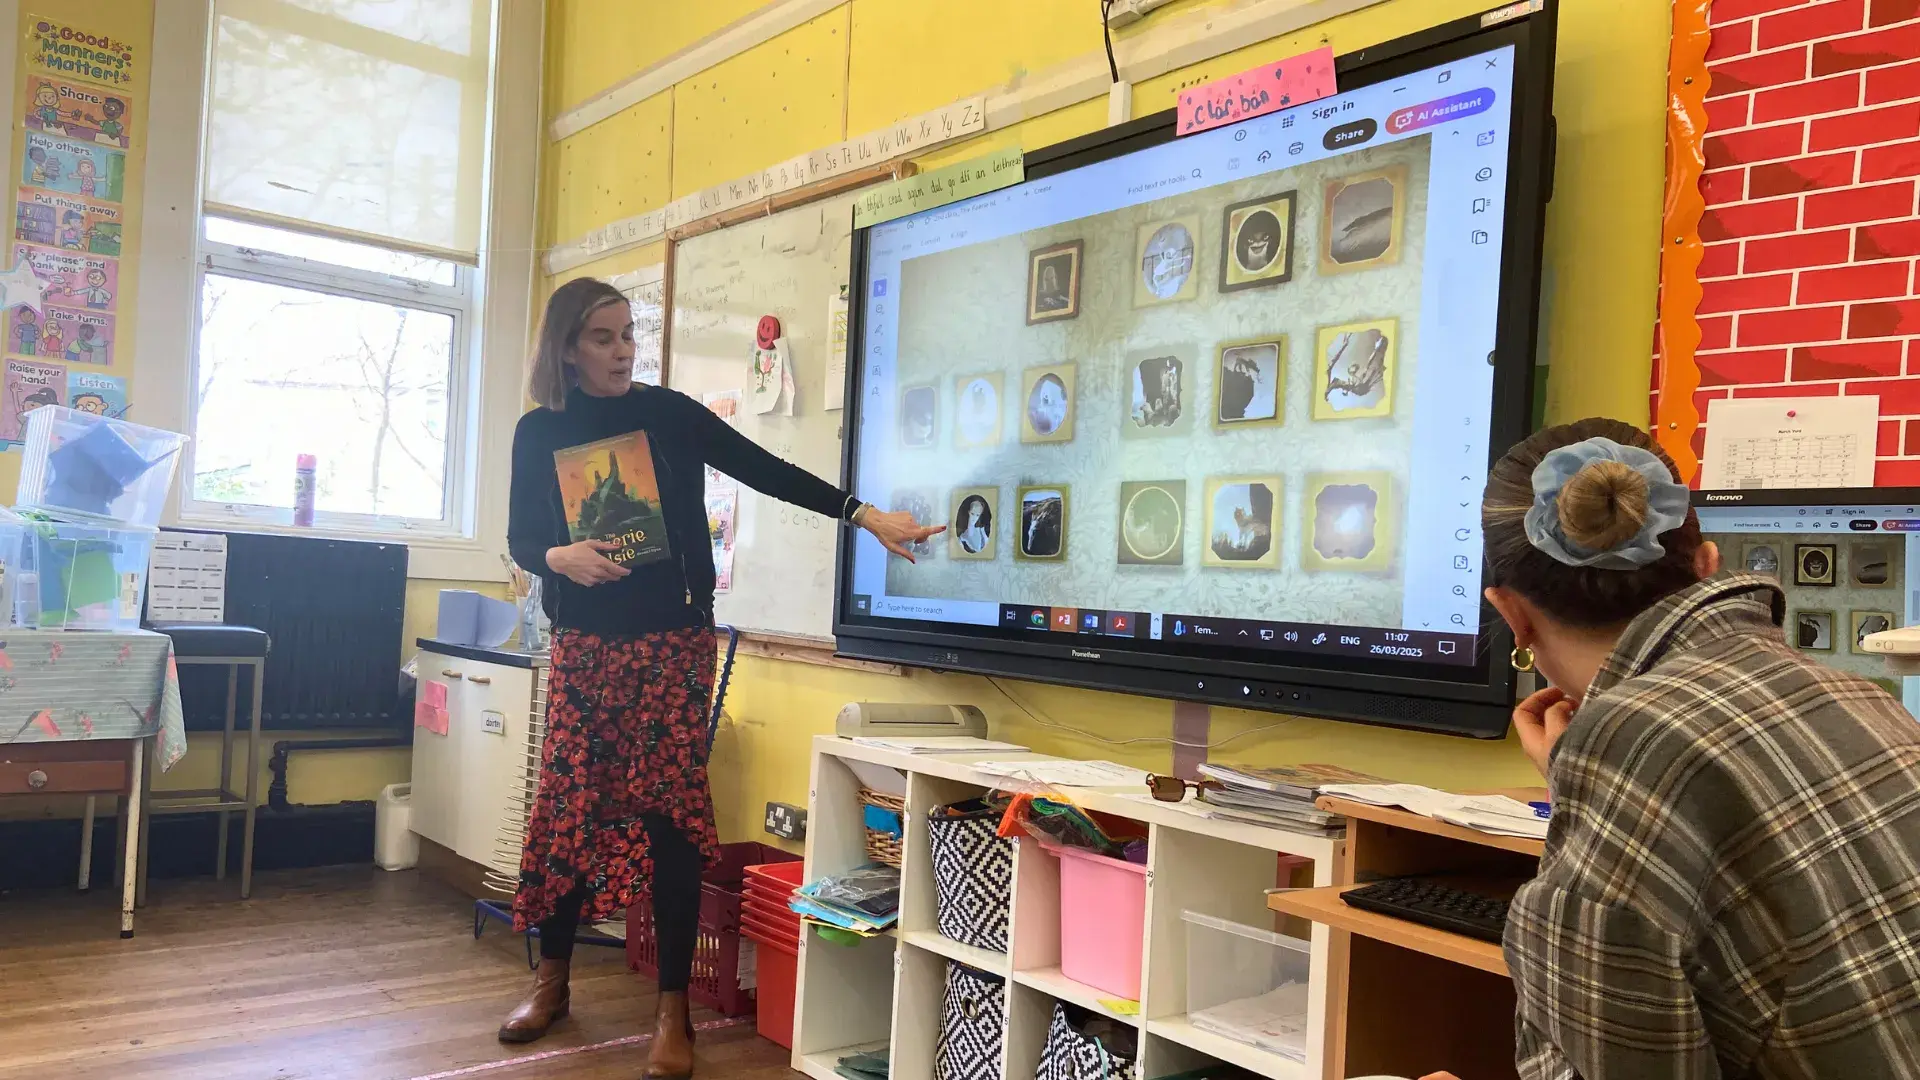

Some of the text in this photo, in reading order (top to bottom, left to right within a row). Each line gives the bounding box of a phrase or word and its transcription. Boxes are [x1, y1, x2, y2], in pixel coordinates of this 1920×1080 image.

[60, 27, 109, 49] Good
[42, 38, 124, 69] Manners
[47, 54, 120, 84] Matter!
[60, 86, 102, 104] Share.
[1312, 100, 1354, 120] Sign in
[1417, 97, 1482, 121] AI Assistant
[1335, 127, 1364, 142] Share
[29, 135, 93, 156] Help others.
[729, 184, 743, 200] Mm
[809, 158, 820, 174] Rr
[826, 152, 837, 171] Ss
[841, 147, 852, 164] Tt
[858, 142, 871, 161] Uu
[878, 136, 890, 153] Vv
[896, 128, 913, 147] Ww
[919, 120, 931, 139] Xx
[941, 112, 953, 138] Yy
[961, 105, 980, 127] Zz
[976, 168, 986, 181] an
[1127, 174, 1186, 195] Find text or tools
[35, 193, 118, 218] Put things away.
[20, 248, 37, 260] Sy
[86, 259, 105, 269] and
[49, 309, 108, 326] Take turns.
[9, 362, 61, 377] Raise your
[20, 374, 49, 385] hand.
[79, 376, 117, 390] Listen.
[1464, 417, 1470, 426] 3
[1464, 445, 1470, 453] 7
[887, 603, 901, 612] Type
[923, 607, 943, 615] search
[1340, 635, 1360, 646] ENG
[1384, 632, 1409, 642] 11:07
[1072, 649, 1101, 659] Promethean
[1370, 644, 1423, 657] 26/03/2025
[1147, 870, 1154, 878] 22
